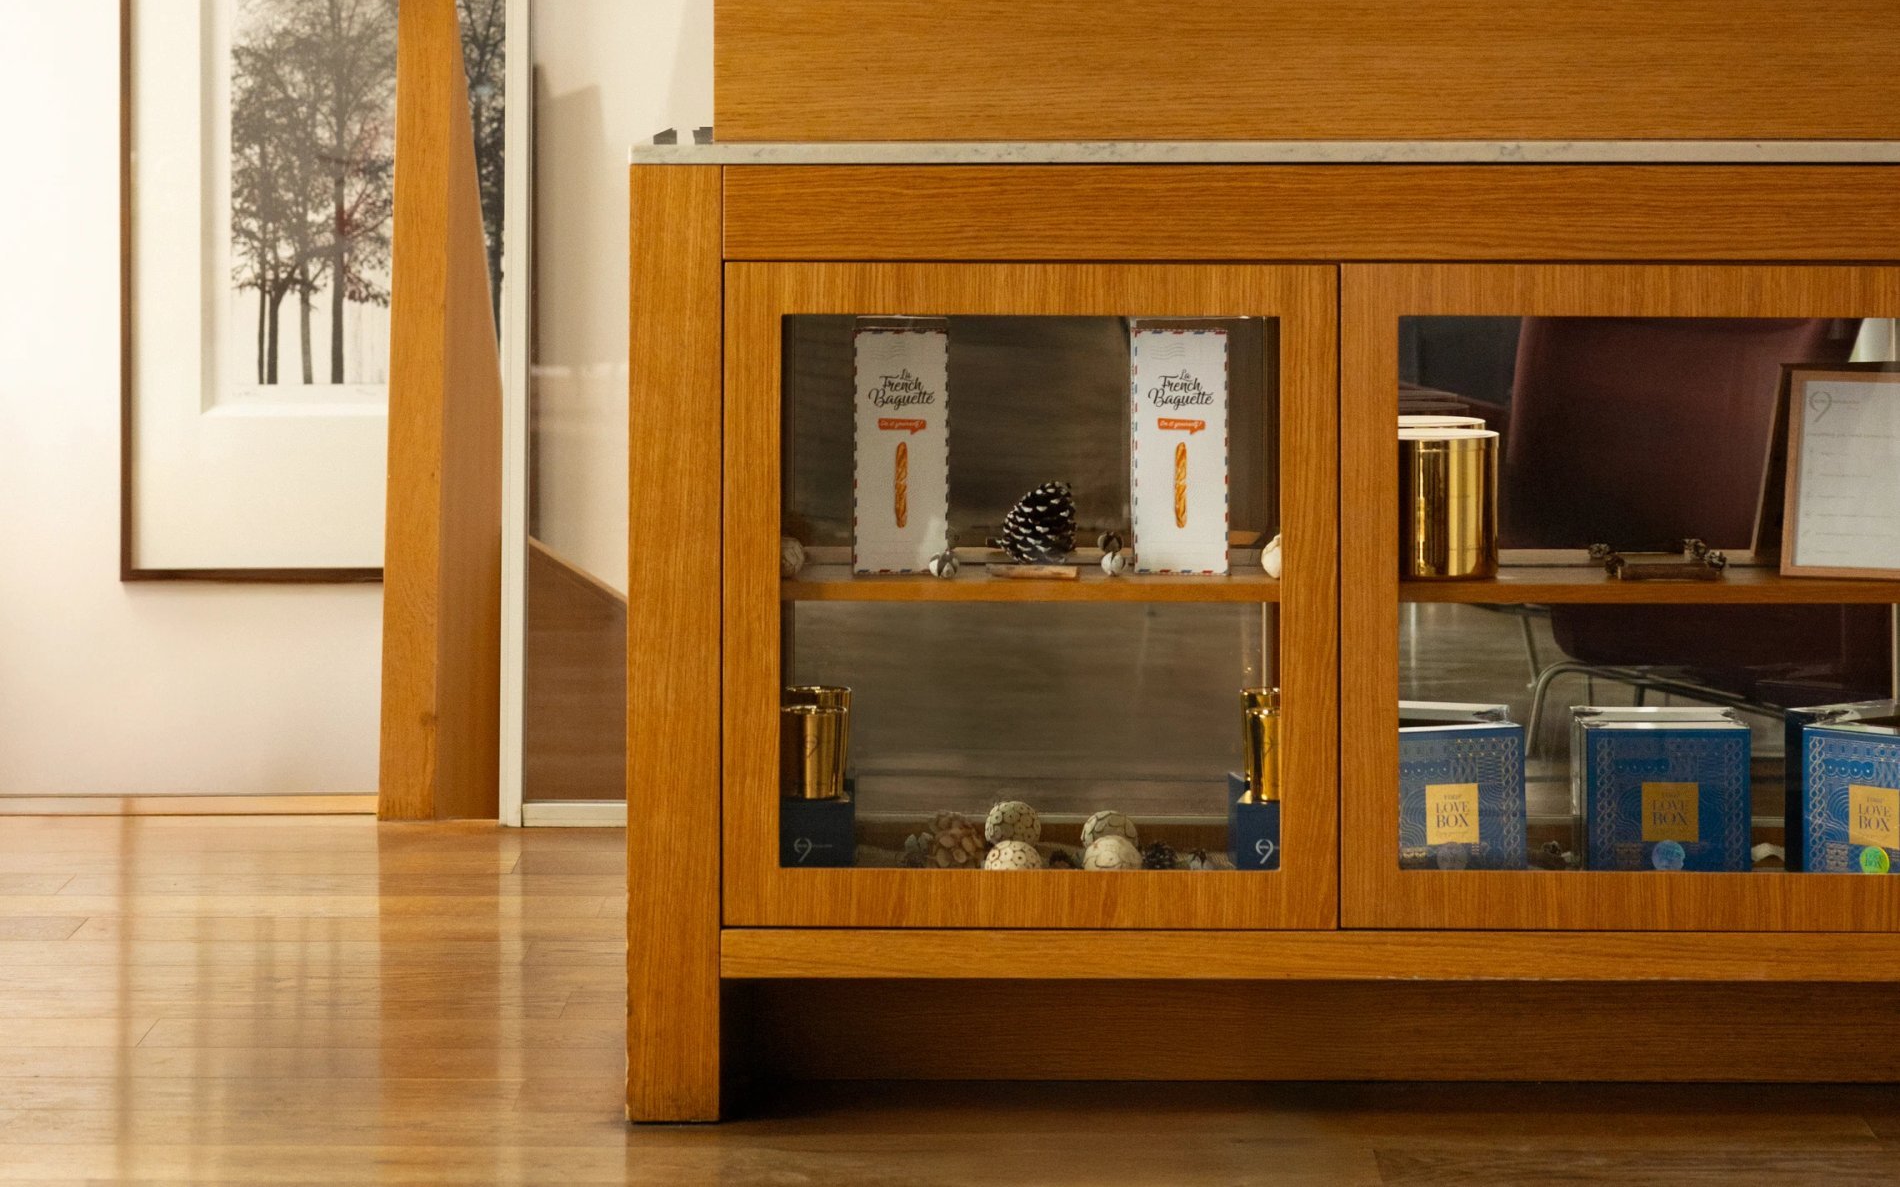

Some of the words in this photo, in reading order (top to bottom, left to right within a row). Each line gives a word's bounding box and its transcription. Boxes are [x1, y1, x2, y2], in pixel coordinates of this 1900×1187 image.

[900, 368, 913, 382] La
[1179, 369, 1193, 382] La
[879, 375, 924, 393] French
[1159, 376, 1203, 393] French
[868, 388, 936, 411] Baguette
[1148, 388, 1215, 411] Baguette
[1435, 801, 1470, 814] LOVE
[1858, 803, 1892, 818] LOVE
[1436, 813, 1470, 829] BOX
[1652, 811, 1688, 827] BOX
[1858, 815, 1890, 832] BOX
[1255, 838, 1274, 864] 9
